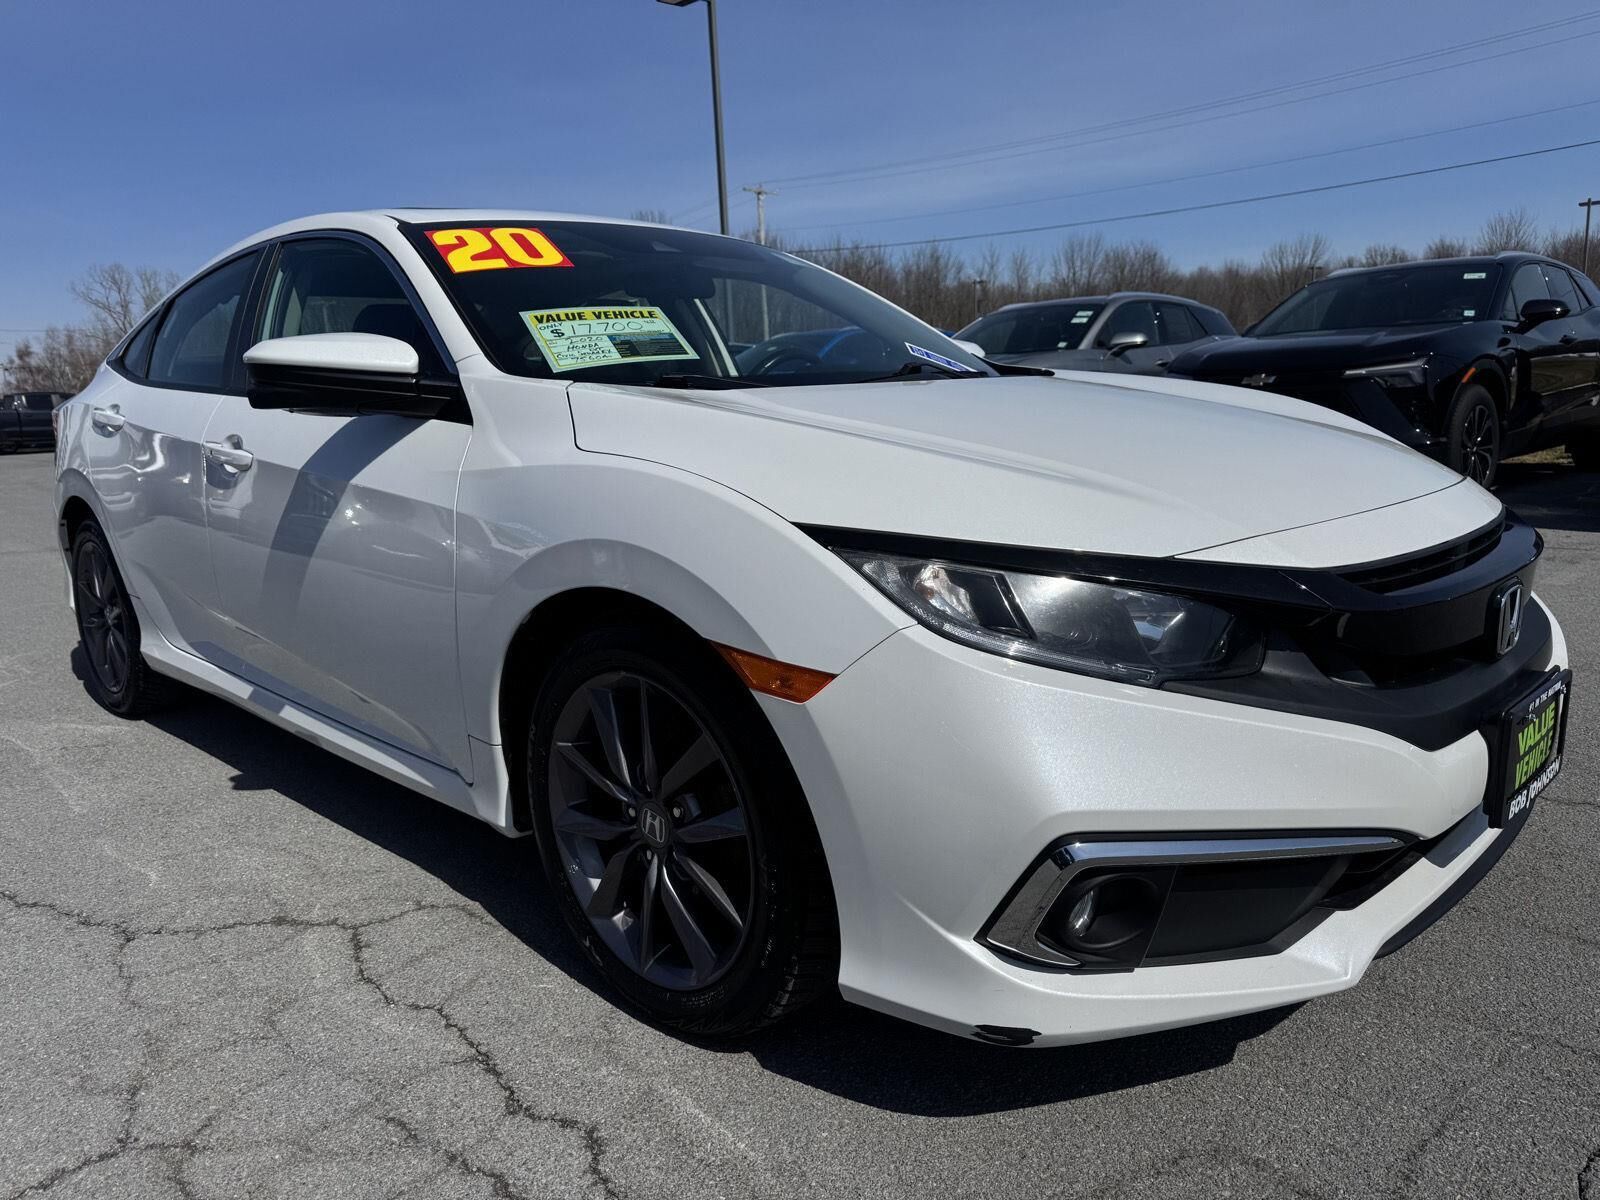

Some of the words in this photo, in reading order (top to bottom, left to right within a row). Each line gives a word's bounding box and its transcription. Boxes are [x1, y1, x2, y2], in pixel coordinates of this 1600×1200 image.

[432, 227, 564, 273] 20
[534, 311, 586, 324] VALUE
[592, 310, 658, 320] VEHICLE
[539, 322, 563, 331] ONLY
[1518, 700, 1556, 757] VALUE
[1514, 732, 1554, 790] VEHICLE
[1508, 788, 1527, 821] BOB
[1526, 755, 1561, 809] JOHNSON
